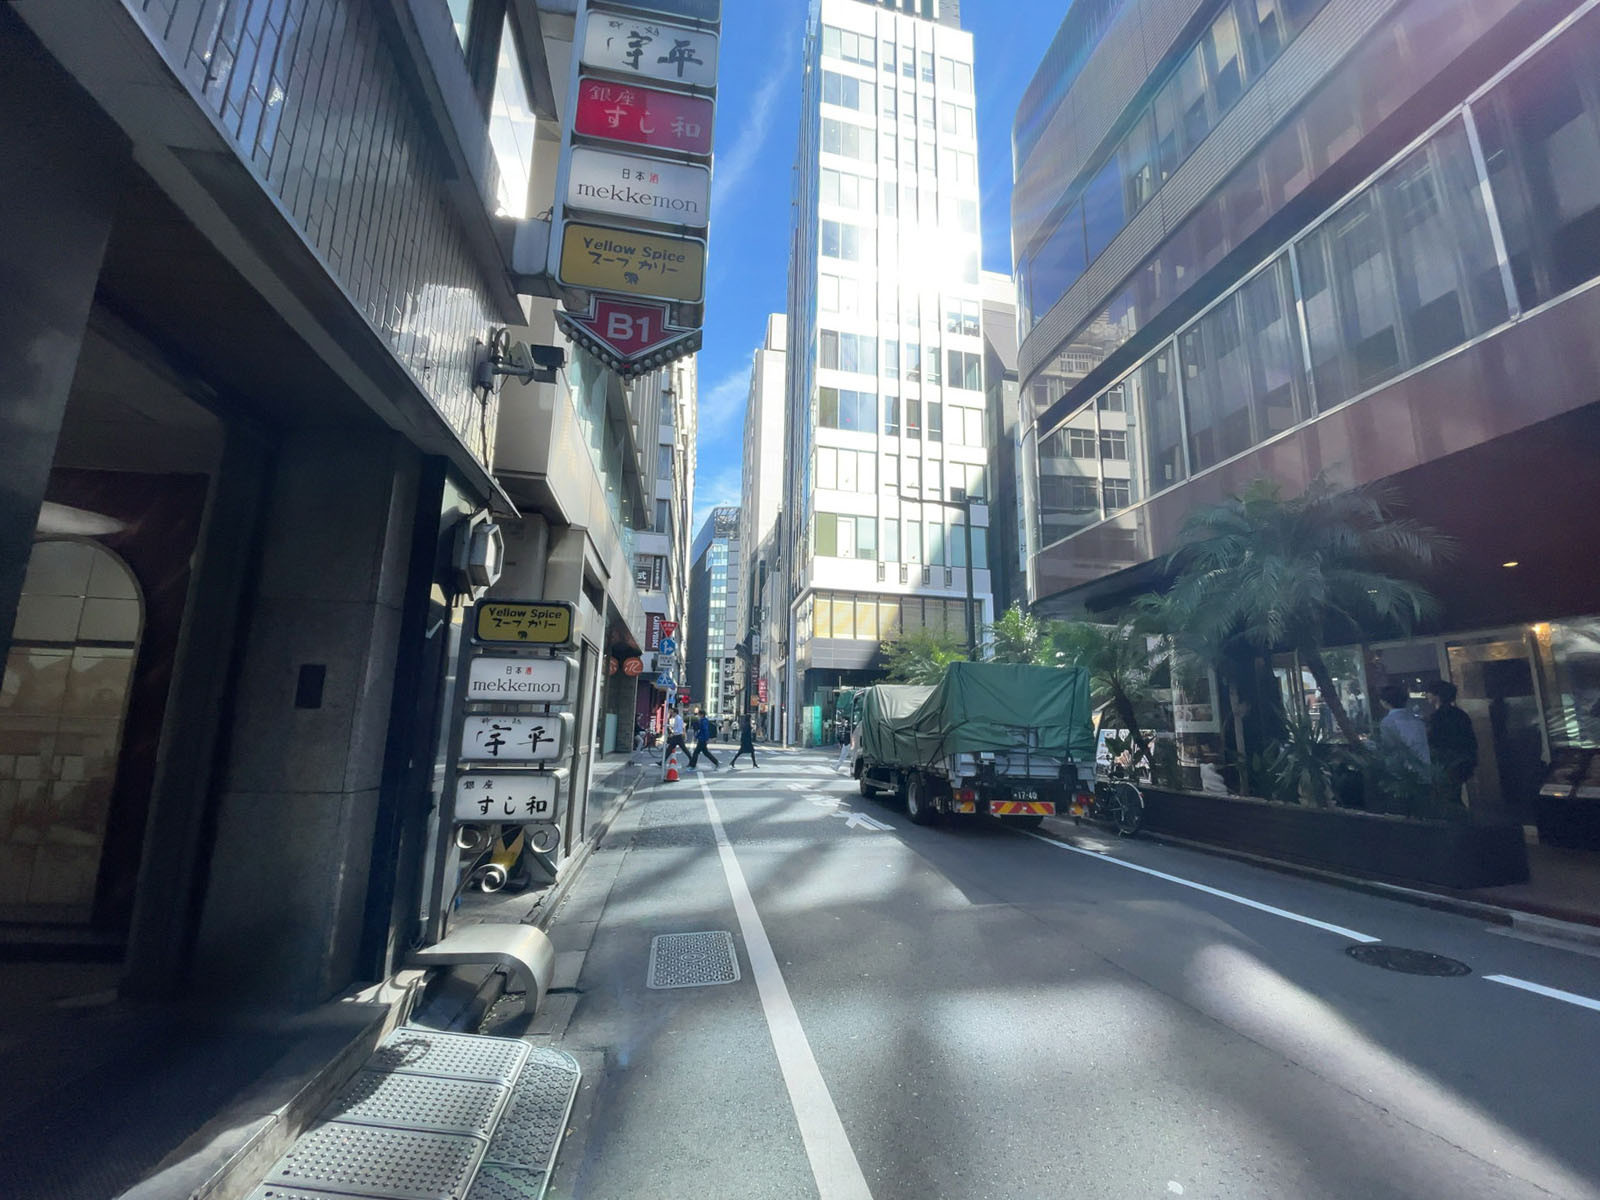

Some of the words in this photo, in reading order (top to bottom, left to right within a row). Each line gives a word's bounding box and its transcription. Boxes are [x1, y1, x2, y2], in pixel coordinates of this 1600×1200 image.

[589, 85, 635, 106] 銀座
[604, 106, 701, 139] すし和
[576, 184, 699, 213] mekkemon
[583, 237, 636, 256] Yellow
[642, 246, 686, 263] Spice
[606, 312, 650, 343] B1
[488, 607, 527, 618] Yellow
[530, 608, 562, 620] Spice
[472, 678, 561, 693] mekkemon
[464, 780, 494, 790] 銀座
[477, 796, 548, 815] すし和
